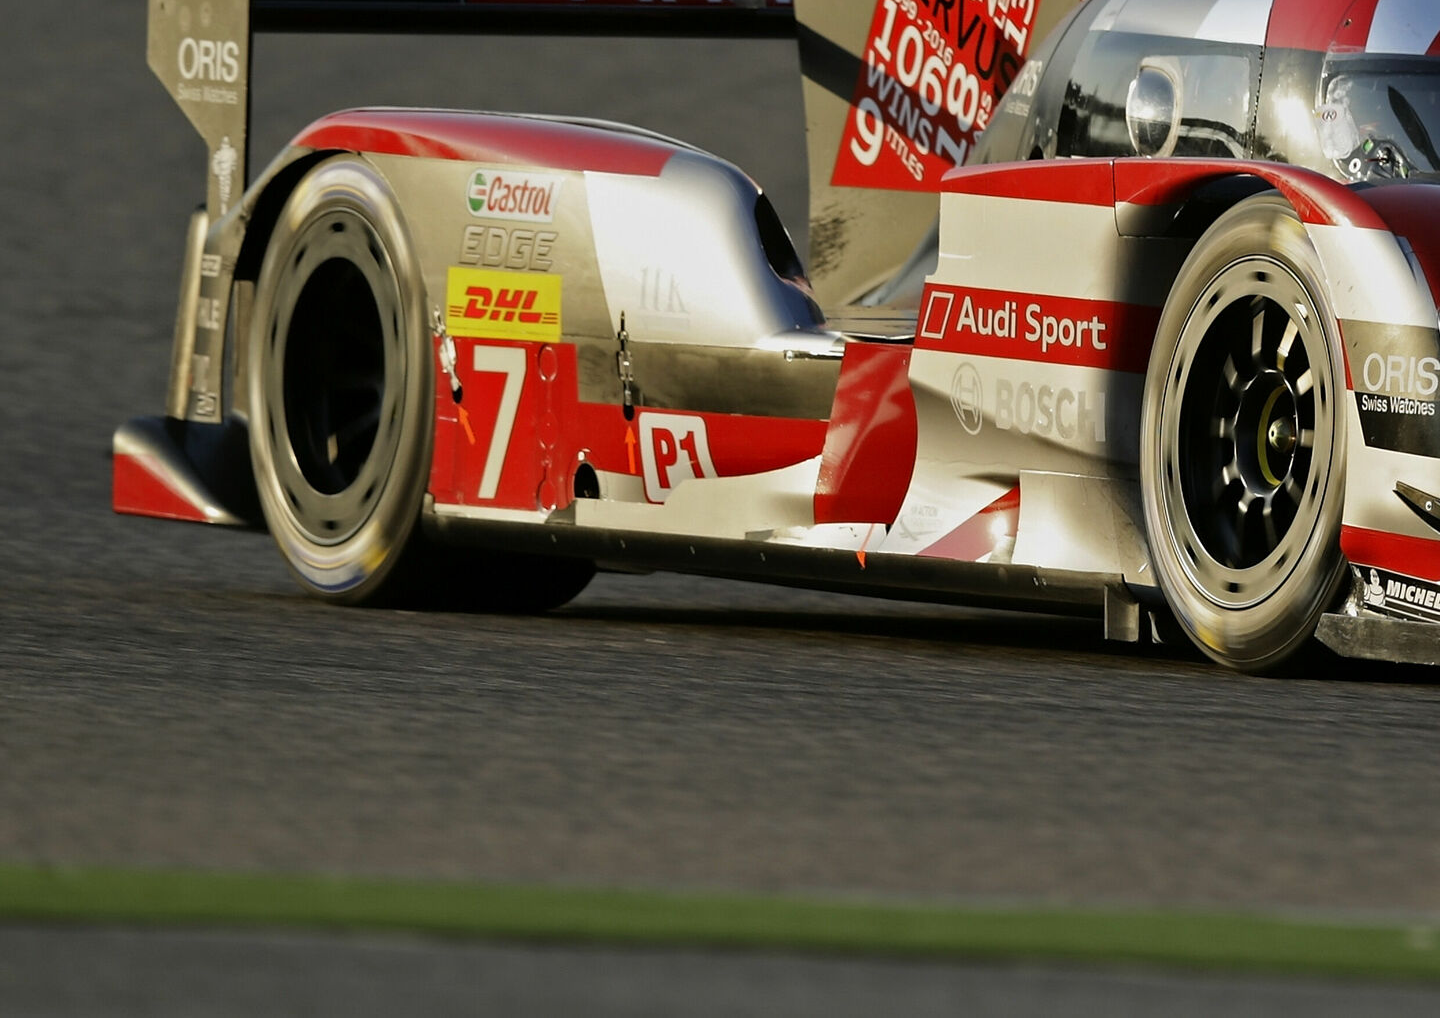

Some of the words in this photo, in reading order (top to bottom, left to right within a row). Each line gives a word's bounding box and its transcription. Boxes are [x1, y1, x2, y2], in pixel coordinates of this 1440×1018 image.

[178, 37, 239, 83] ORIS
[924, 25, 954, 67] 2016
[866, 49, 932, 156] WINS
[851, 96, 884, 166] 9
[885, 124, 924, 182] TITLES
[486, 176, 555, 217] Castrol
[458, 225, 558, 272] EDGE
[463, 286, 544, 323] DHL
[956, 296, 1017, 339] Audi
[1024, 303, 1108, 353] Sport
[1363, 352, 1440, 397] ORIS
[473, 344, 527, 500] 7
[995, 378, 1106, 443] BOSCH
[1361, 394, 1388, 414] Swiss
[1389, 396, 1435, 417] Watches
[651, 427, 706, 490] P1
